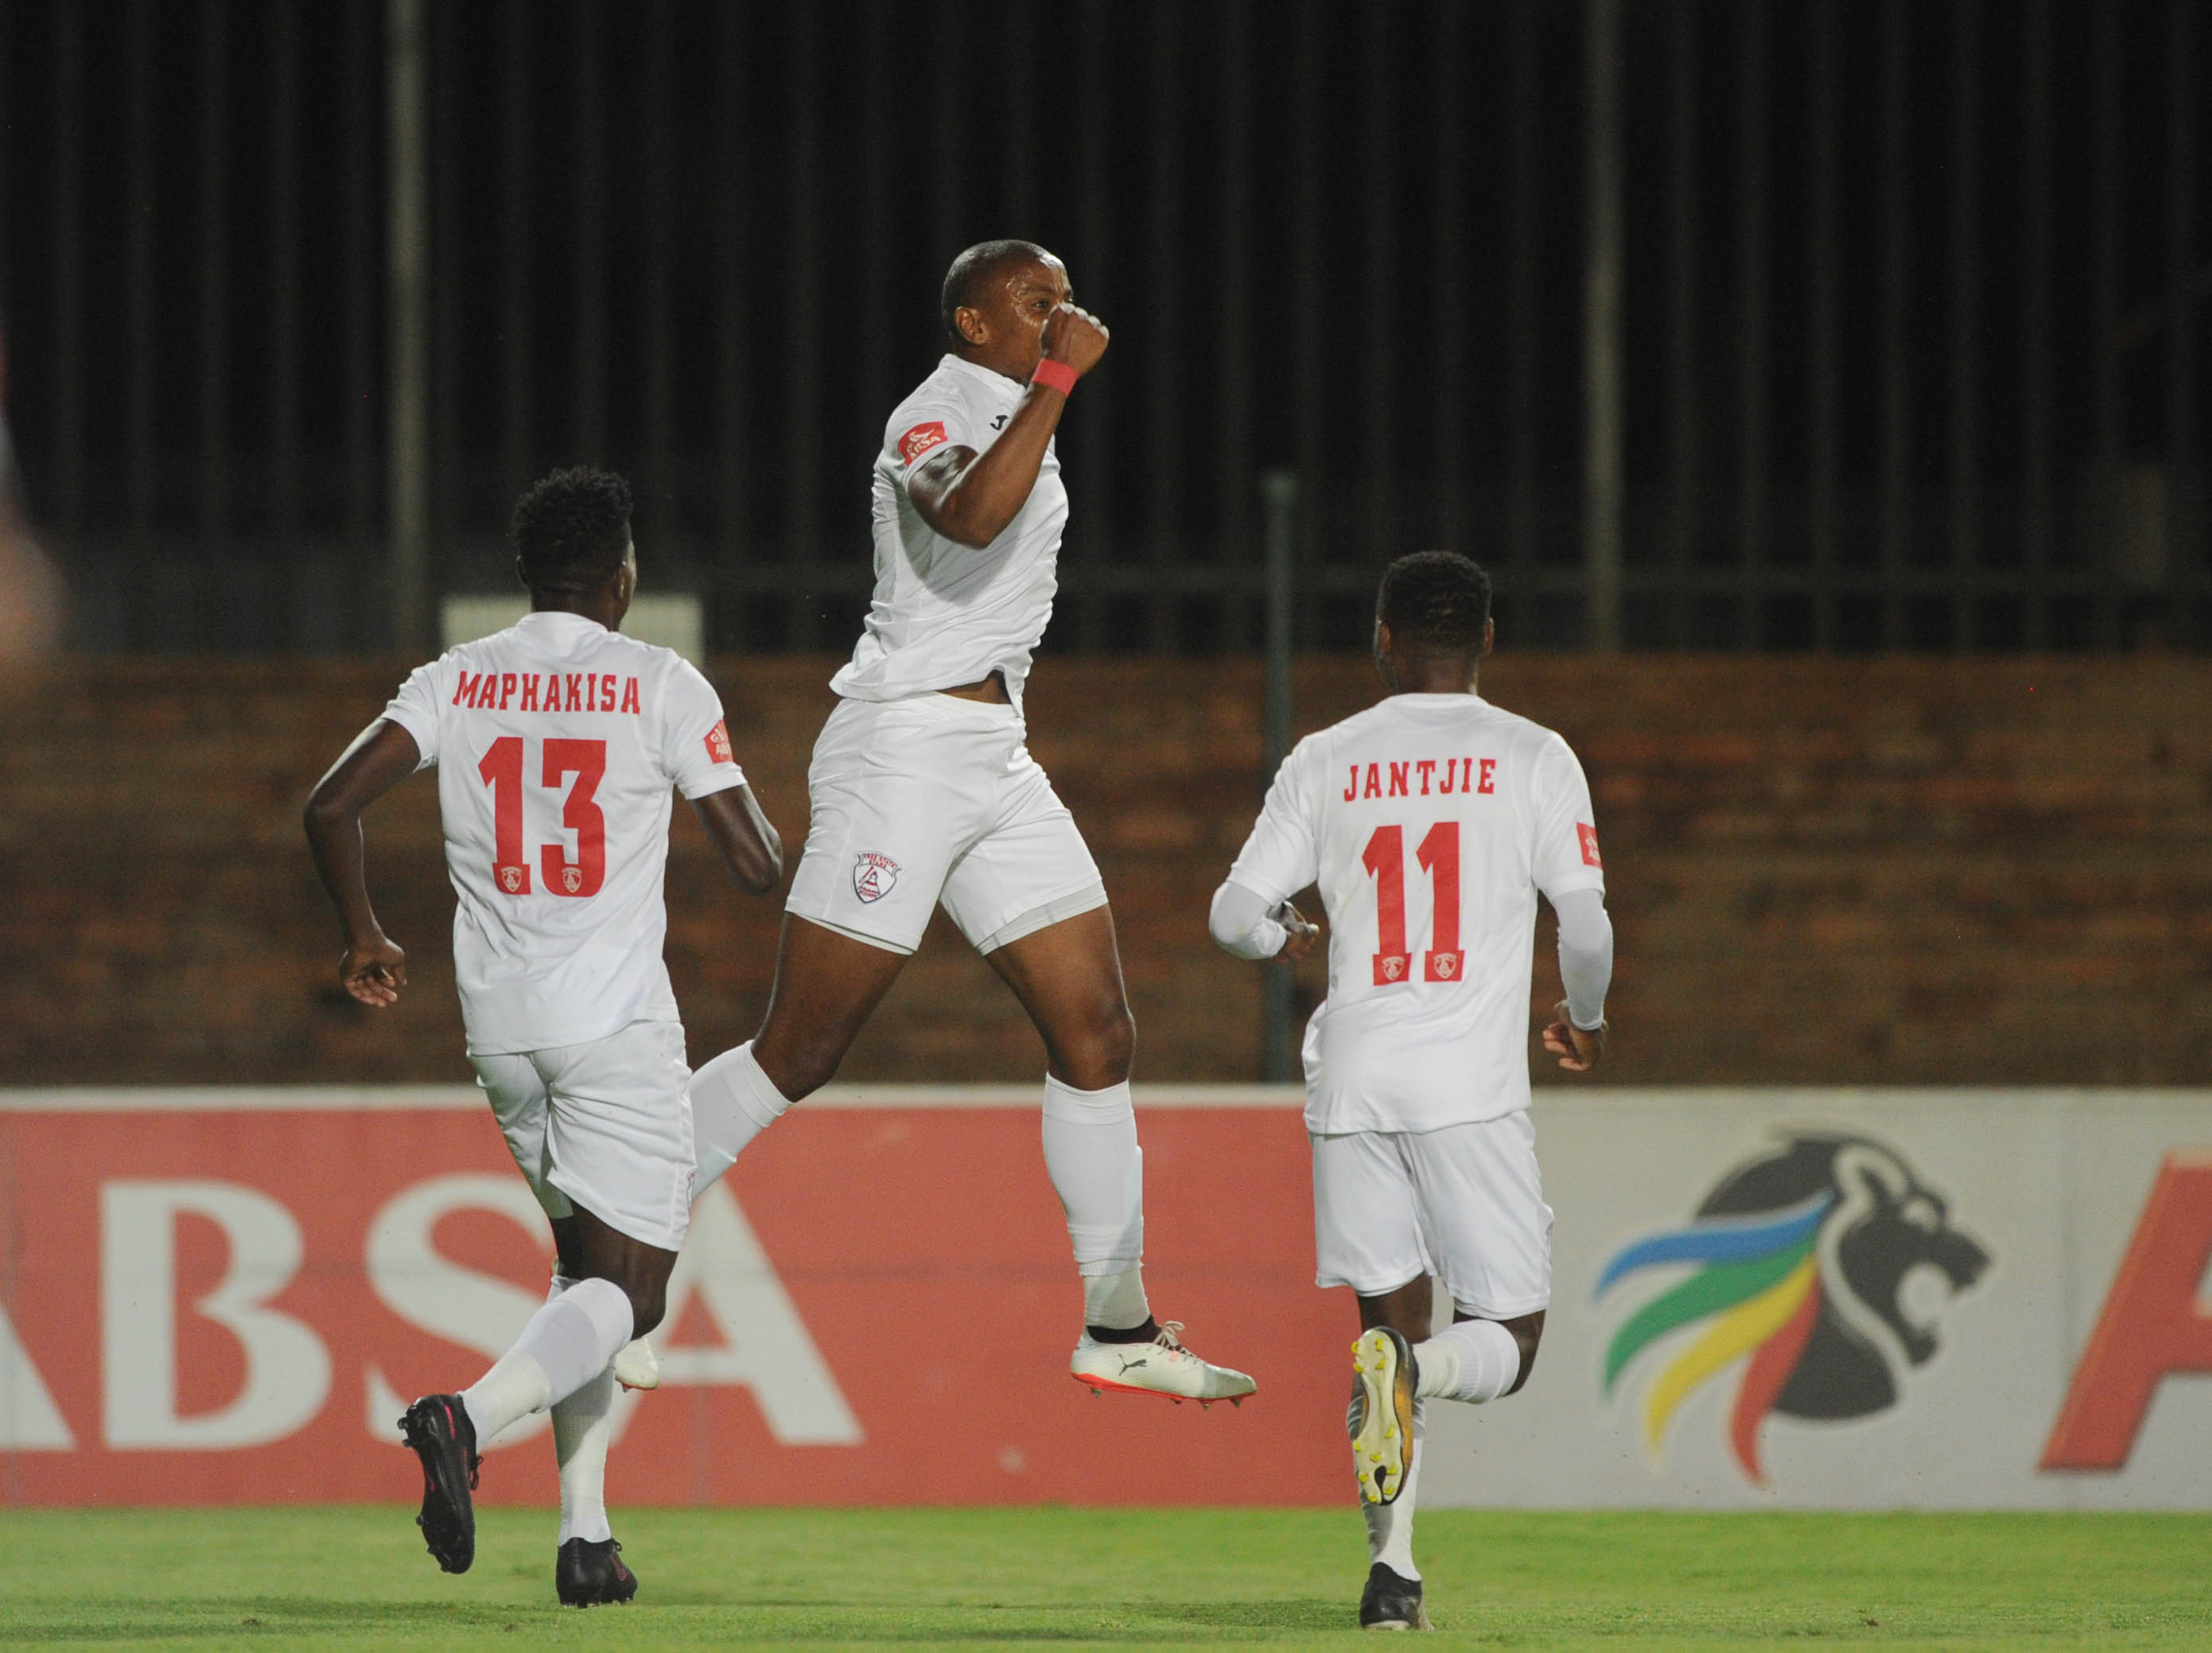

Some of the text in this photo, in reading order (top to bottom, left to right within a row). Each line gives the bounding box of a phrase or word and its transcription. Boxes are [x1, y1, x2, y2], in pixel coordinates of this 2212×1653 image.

[453, 671, 640, 714] MAPHAKISA
[478, 736, 607, 897] 13
[1344, 757, 1496, 802] JANTJIE
[1362, 821, 1466, 986] 11
